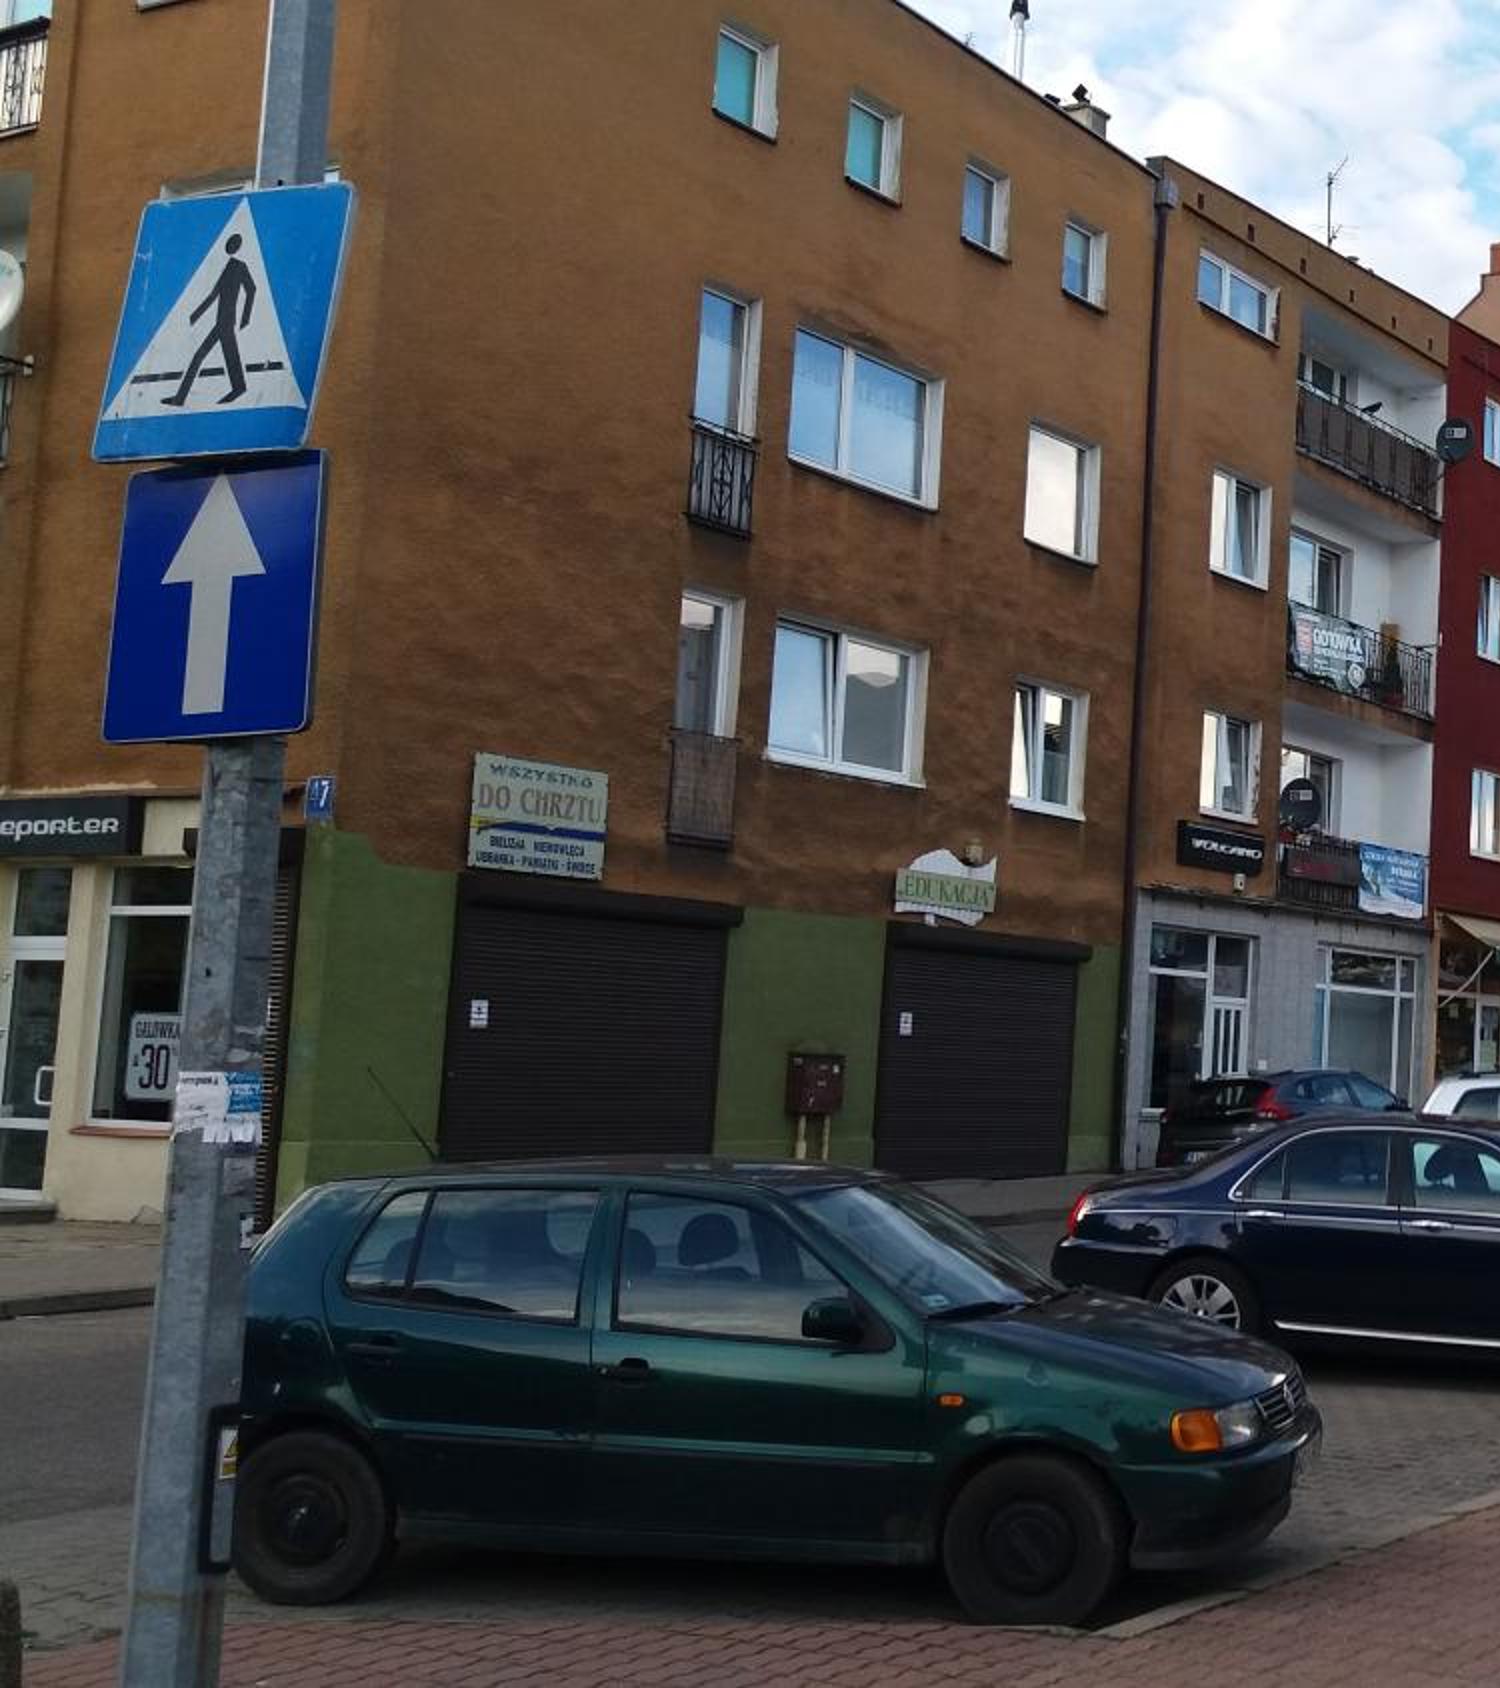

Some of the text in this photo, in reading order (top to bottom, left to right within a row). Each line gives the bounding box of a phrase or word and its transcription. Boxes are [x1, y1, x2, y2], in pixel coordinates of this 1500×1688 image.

[490, 763, 593, 789] WSZYSTKO
[479, 783, 605, 823] DO CHRZTU
[138, 1044, 170, 1090] 30
